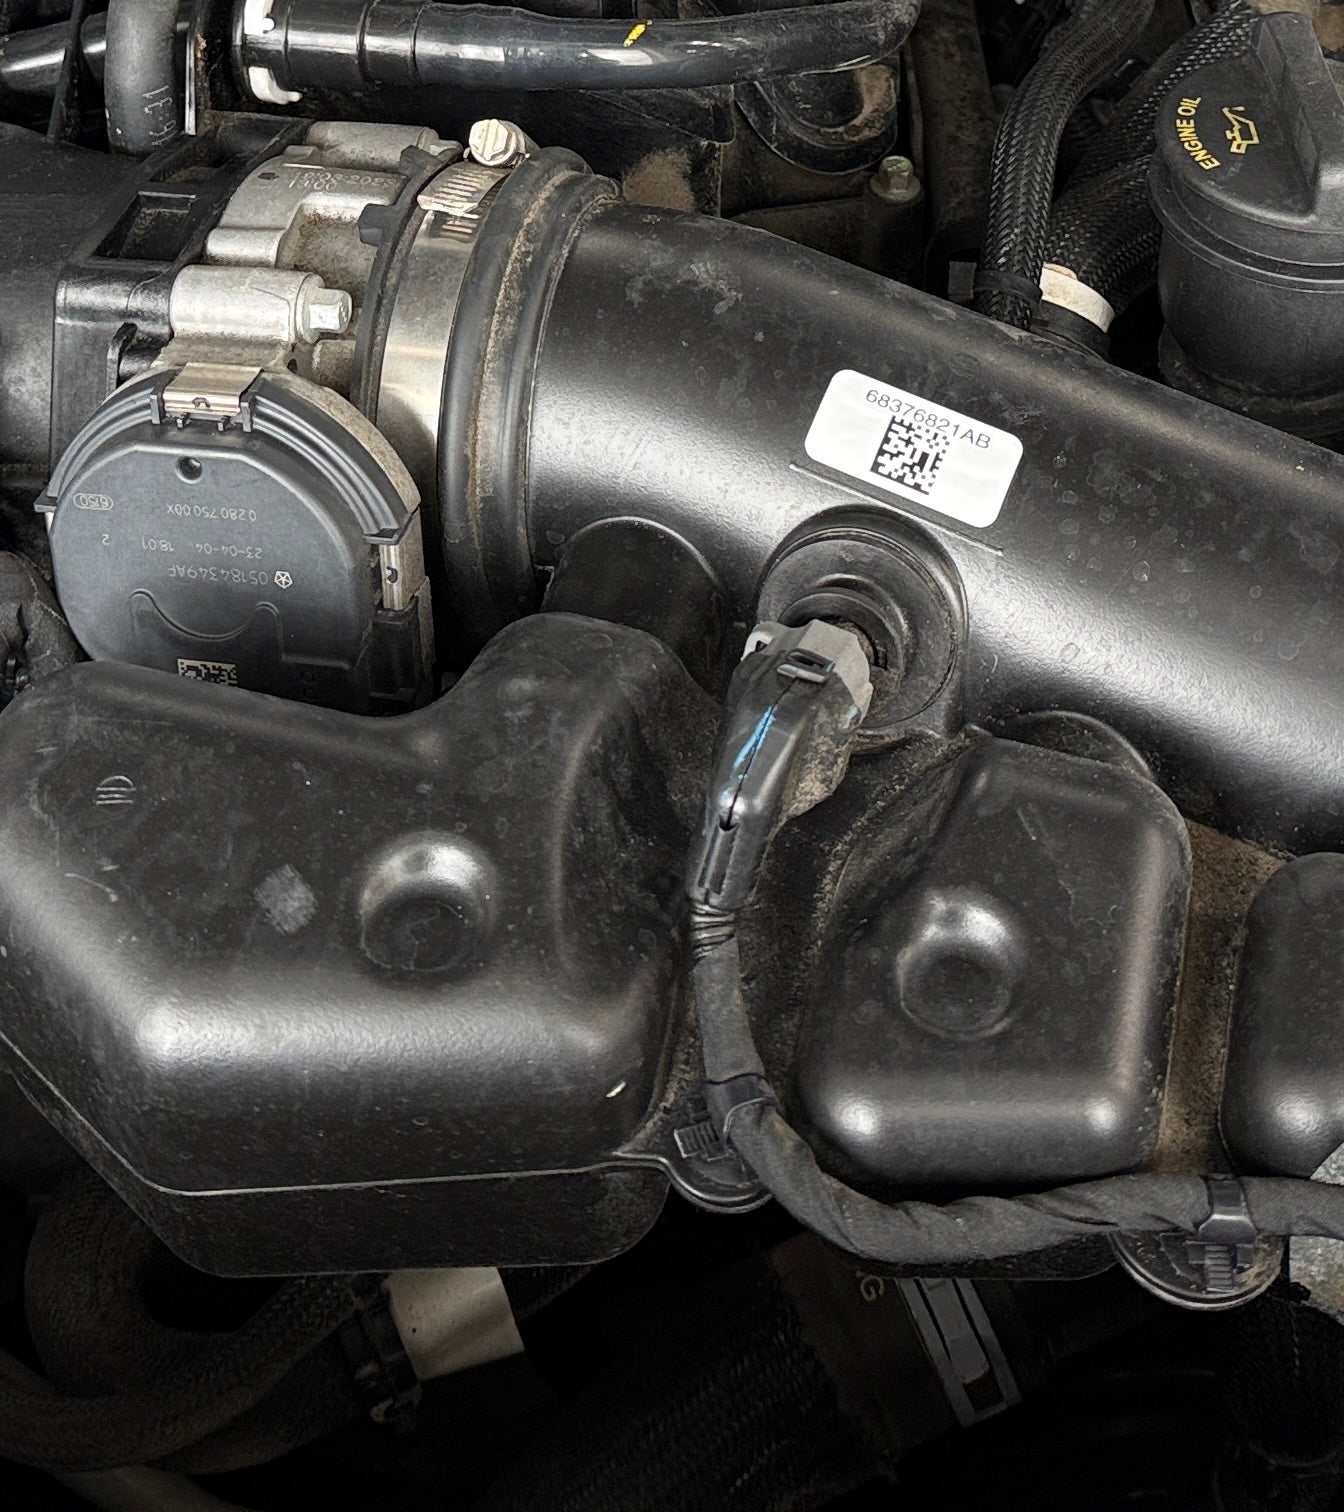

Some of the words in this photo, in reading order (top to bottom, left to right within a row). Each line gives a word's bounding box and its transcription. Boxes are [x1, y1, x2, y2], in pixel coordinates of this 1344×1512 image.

[1177, 96, 1202, 118] OIL
[1175, 119, 1222, 172] ENGINE
[865, 389, 992, 449] 68376821AB
[194, 543, 263, 560] 23-04-04
[167, 566, 269, 586] 05184349AF
